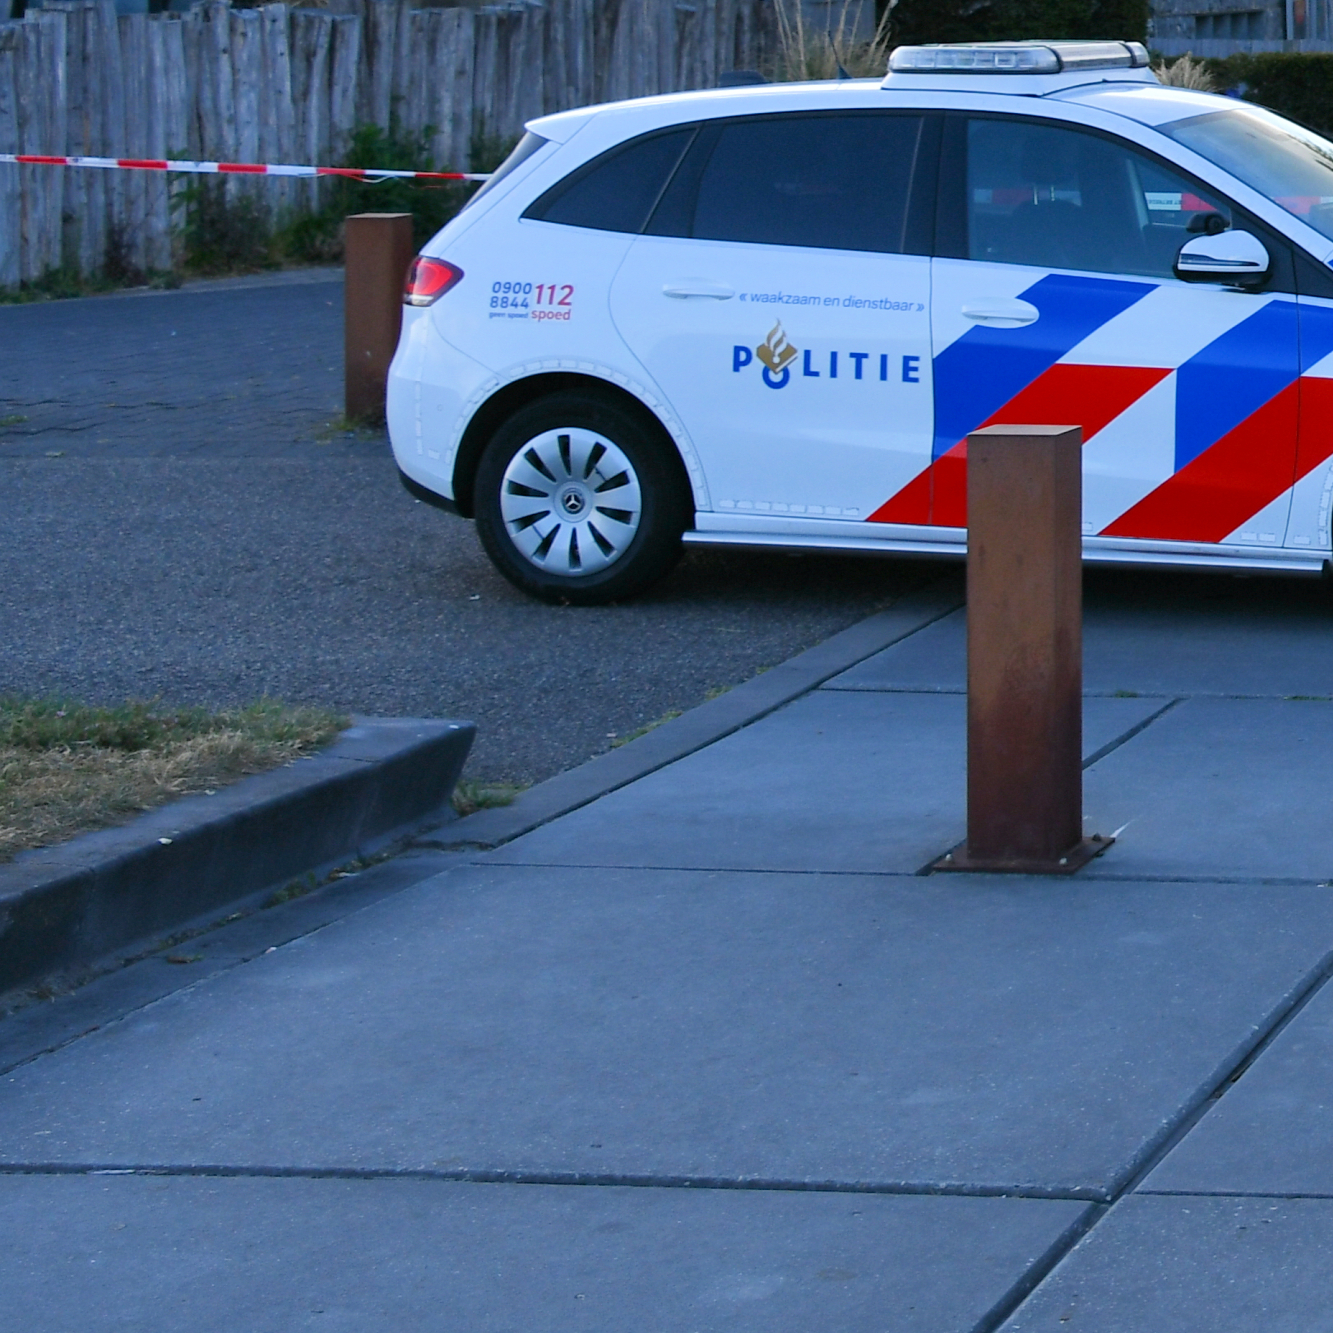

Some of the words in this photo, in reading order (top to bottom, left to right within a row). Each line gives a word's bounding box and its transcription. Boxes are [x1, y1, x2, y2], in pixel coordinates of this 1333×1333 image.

[492, 281, 532, 295] 0900
[535, 284, 575, 306] 112
[489, 296, 529, 309] 8844
[750, 291, 820, 306] waakzaam
[823, 298, 839, 308] en
[842, 295, 914, 311] dienstbaar
[531, 309, 571, 322] spoed
[732, 346, 921, 389] POLITIE
